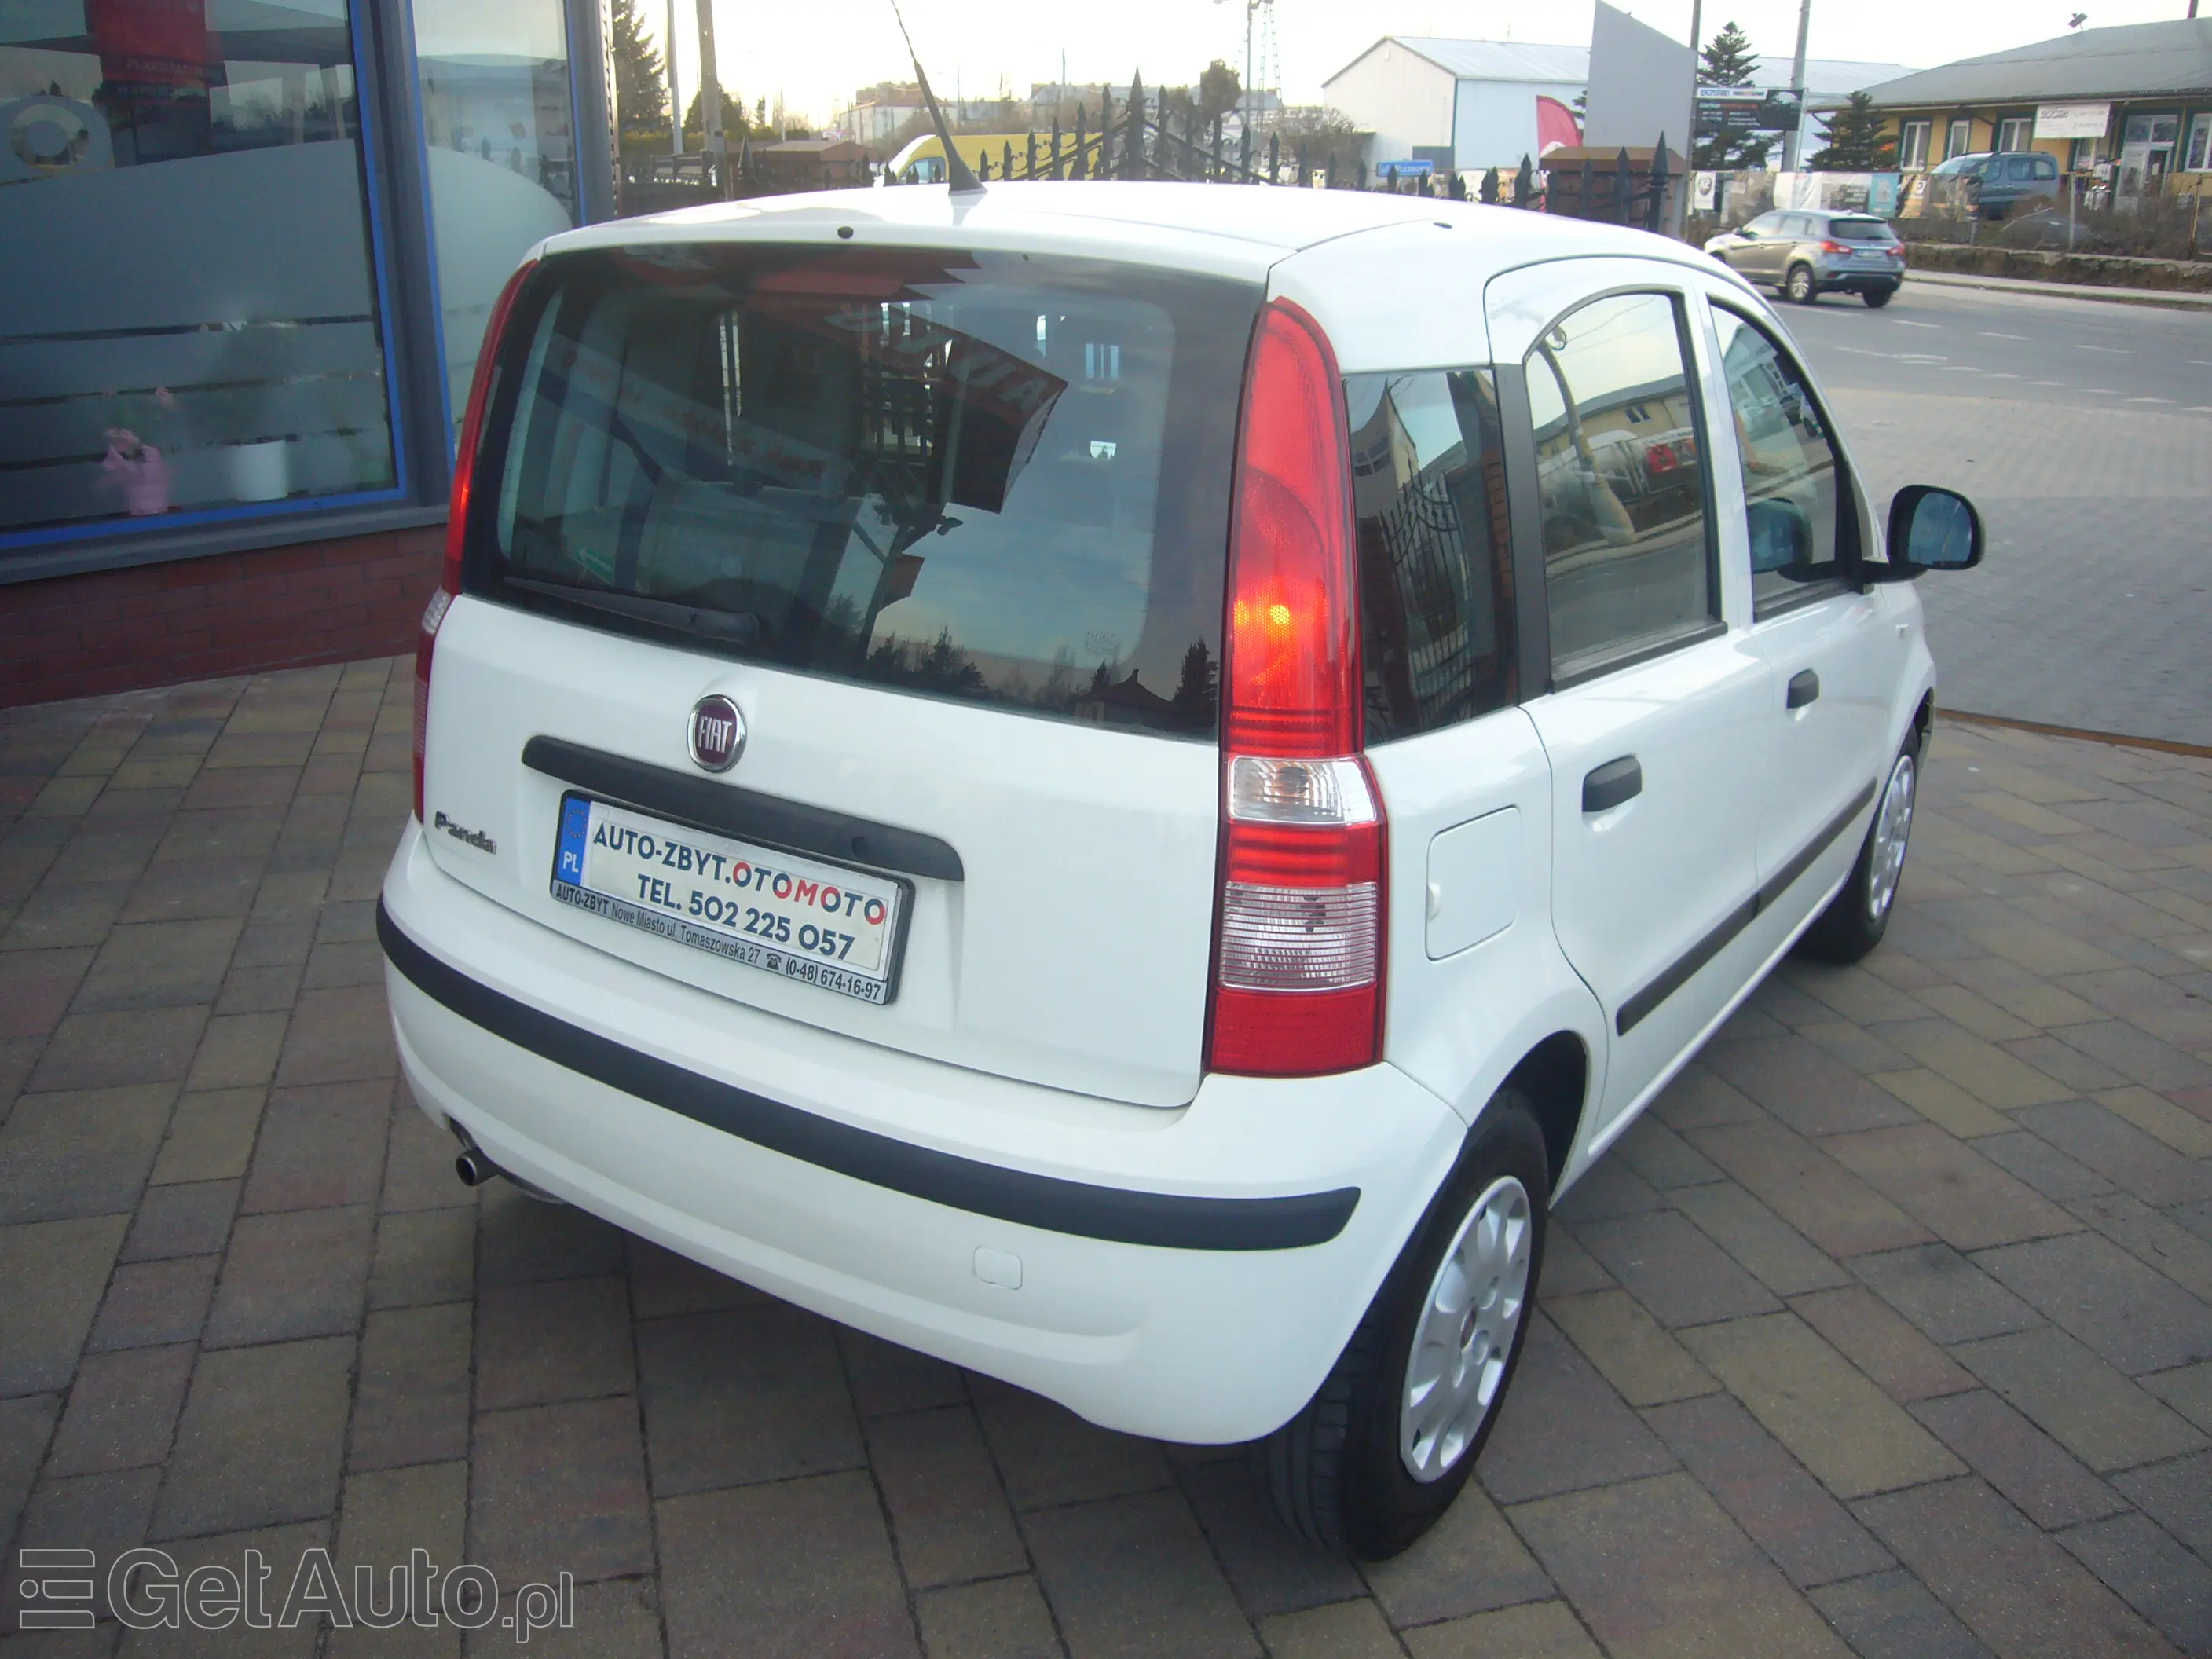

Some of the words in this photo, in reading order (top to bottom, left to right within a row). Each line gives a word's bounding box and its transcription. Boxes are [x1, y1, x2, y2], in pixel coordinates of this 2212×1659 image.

[697, 715, 733, 754] FIAT
[434, 810, 497, 855] Panda
[562, 851, 580, 873] PL
[593, 822, 886, 925] AUTO-ZBYT.OTOMOTO
[555, 883, 610, 916] AUTO-ZBYT
[611, 903, 635, 924] Nowe
[636, 910, 665, 933] Miasto
[667, 923, 678, 939] ul.
[680, 925, 745, 961] Tomaszowska
[746, 947, 761, 964] 27
[786, 956, 819, 983] (0-48)
[820, 969, 881, 1001] 674-16-97
[637, 873, 683, 911] TEL.
[688, 890, 738, 928] 502
[744, 907, 791, 943] 225
[798, 924, 855, 960] 057
